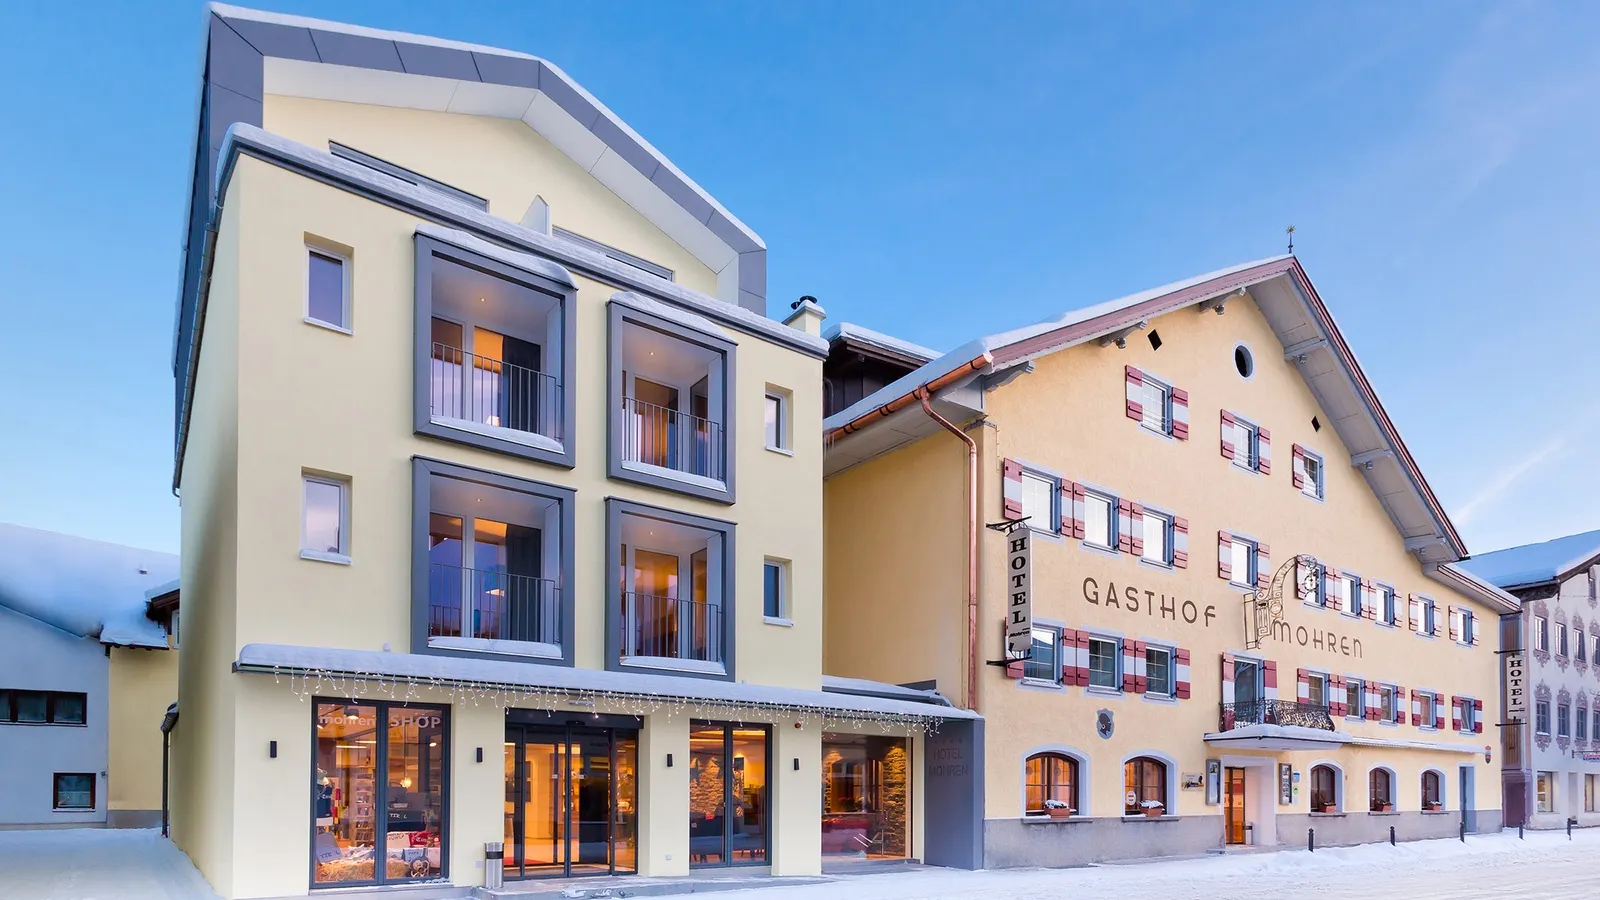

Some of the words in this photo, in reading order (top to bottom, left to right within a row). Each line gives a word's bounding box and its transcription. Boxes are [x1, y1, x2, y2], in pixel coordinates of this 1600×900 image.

[1010, 537, 1027, 625] HOTEL
[1082, 577, 1217, 627] GASTHOF
[1272, 620, 1363, 658] MOHREN
[1509, 660, 1523, 706] HOTEL
[390, 715, 441, 729] SHOP
[928, 763, 968, 777] MOHREN
[933, 747, 964, 760] HOTEL
